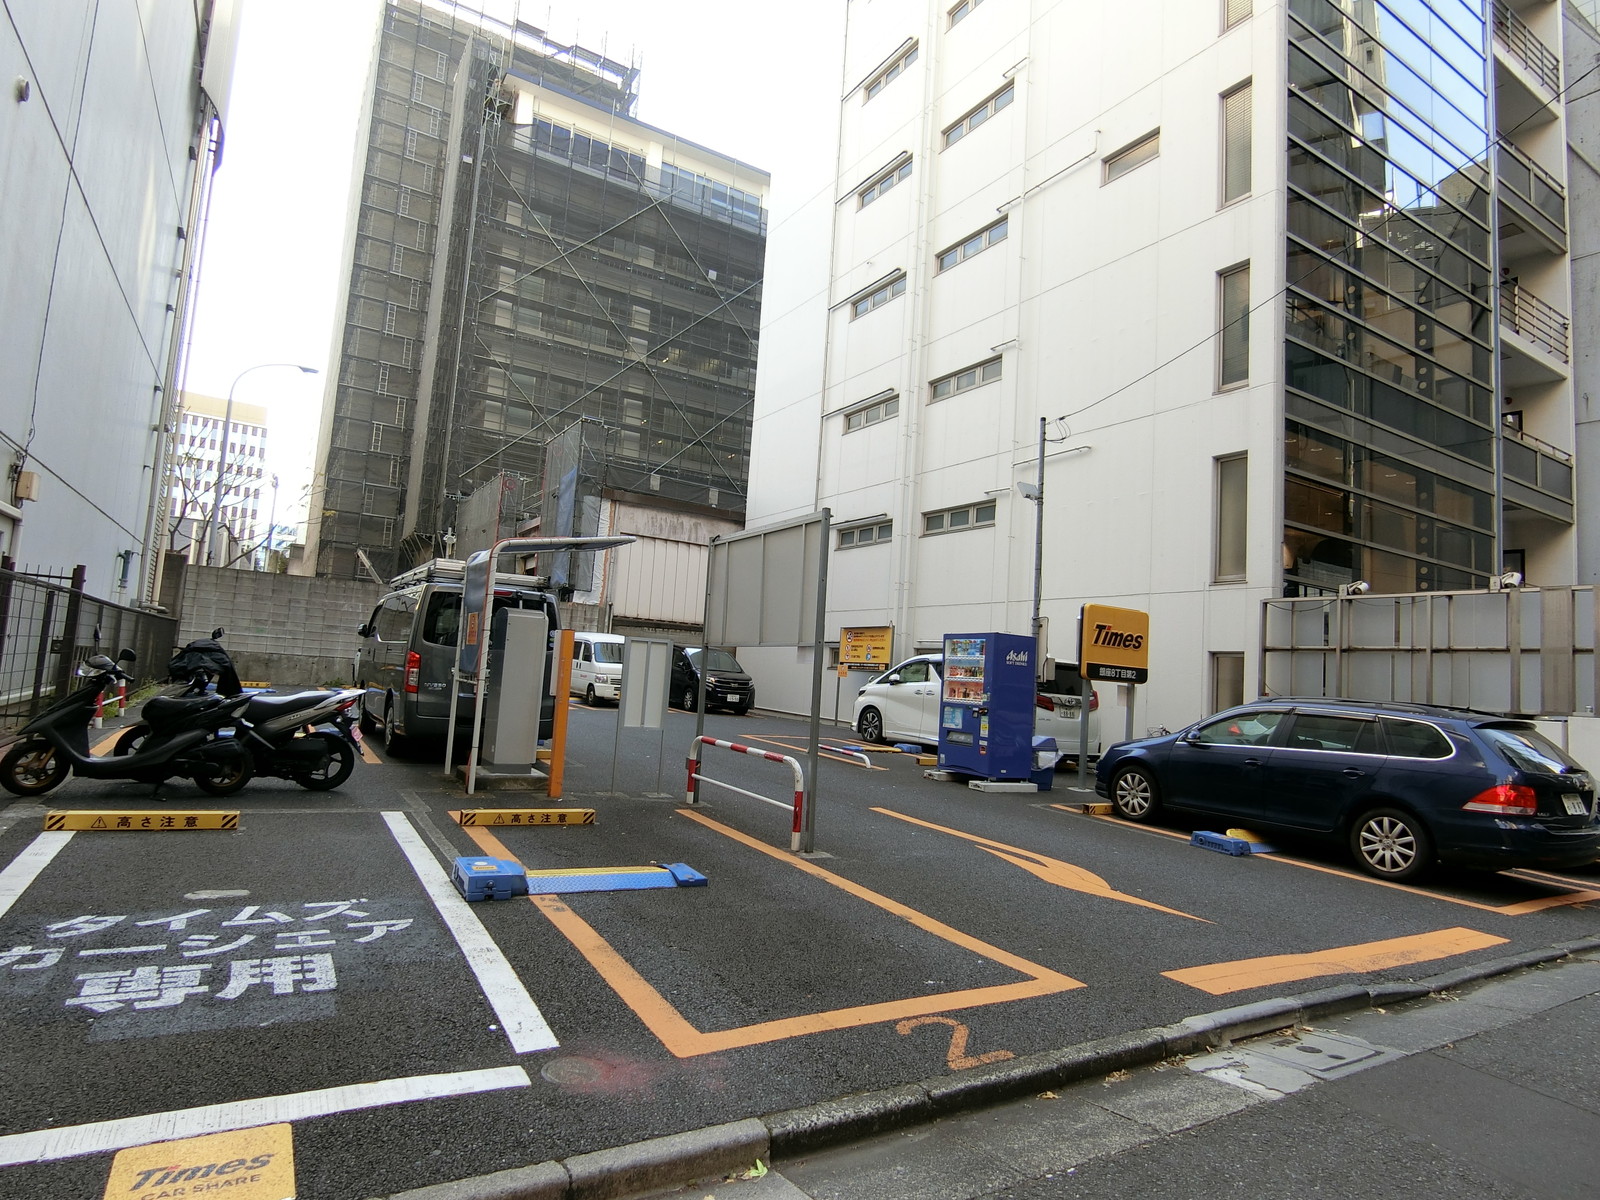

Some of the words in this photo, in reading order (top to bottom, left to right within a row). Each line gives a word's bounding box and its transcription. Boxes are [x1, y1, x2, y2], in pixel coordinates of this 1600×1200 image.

[1093, 623, 1144, 650] Times
[1006, 649, 1029, 662] Asahi
[116, 816, 199, 828] 高さ注意
[511, 813, 568, 824] 高さ注意
[46, 898, 370, 939] タイムズ
[65, 952, 338, 1013] 専用
[895, 1016, 1016, 1071] 2
[129, 1153, 275, 1192] Times
[192, 1173, 262, 1193] SHARE
